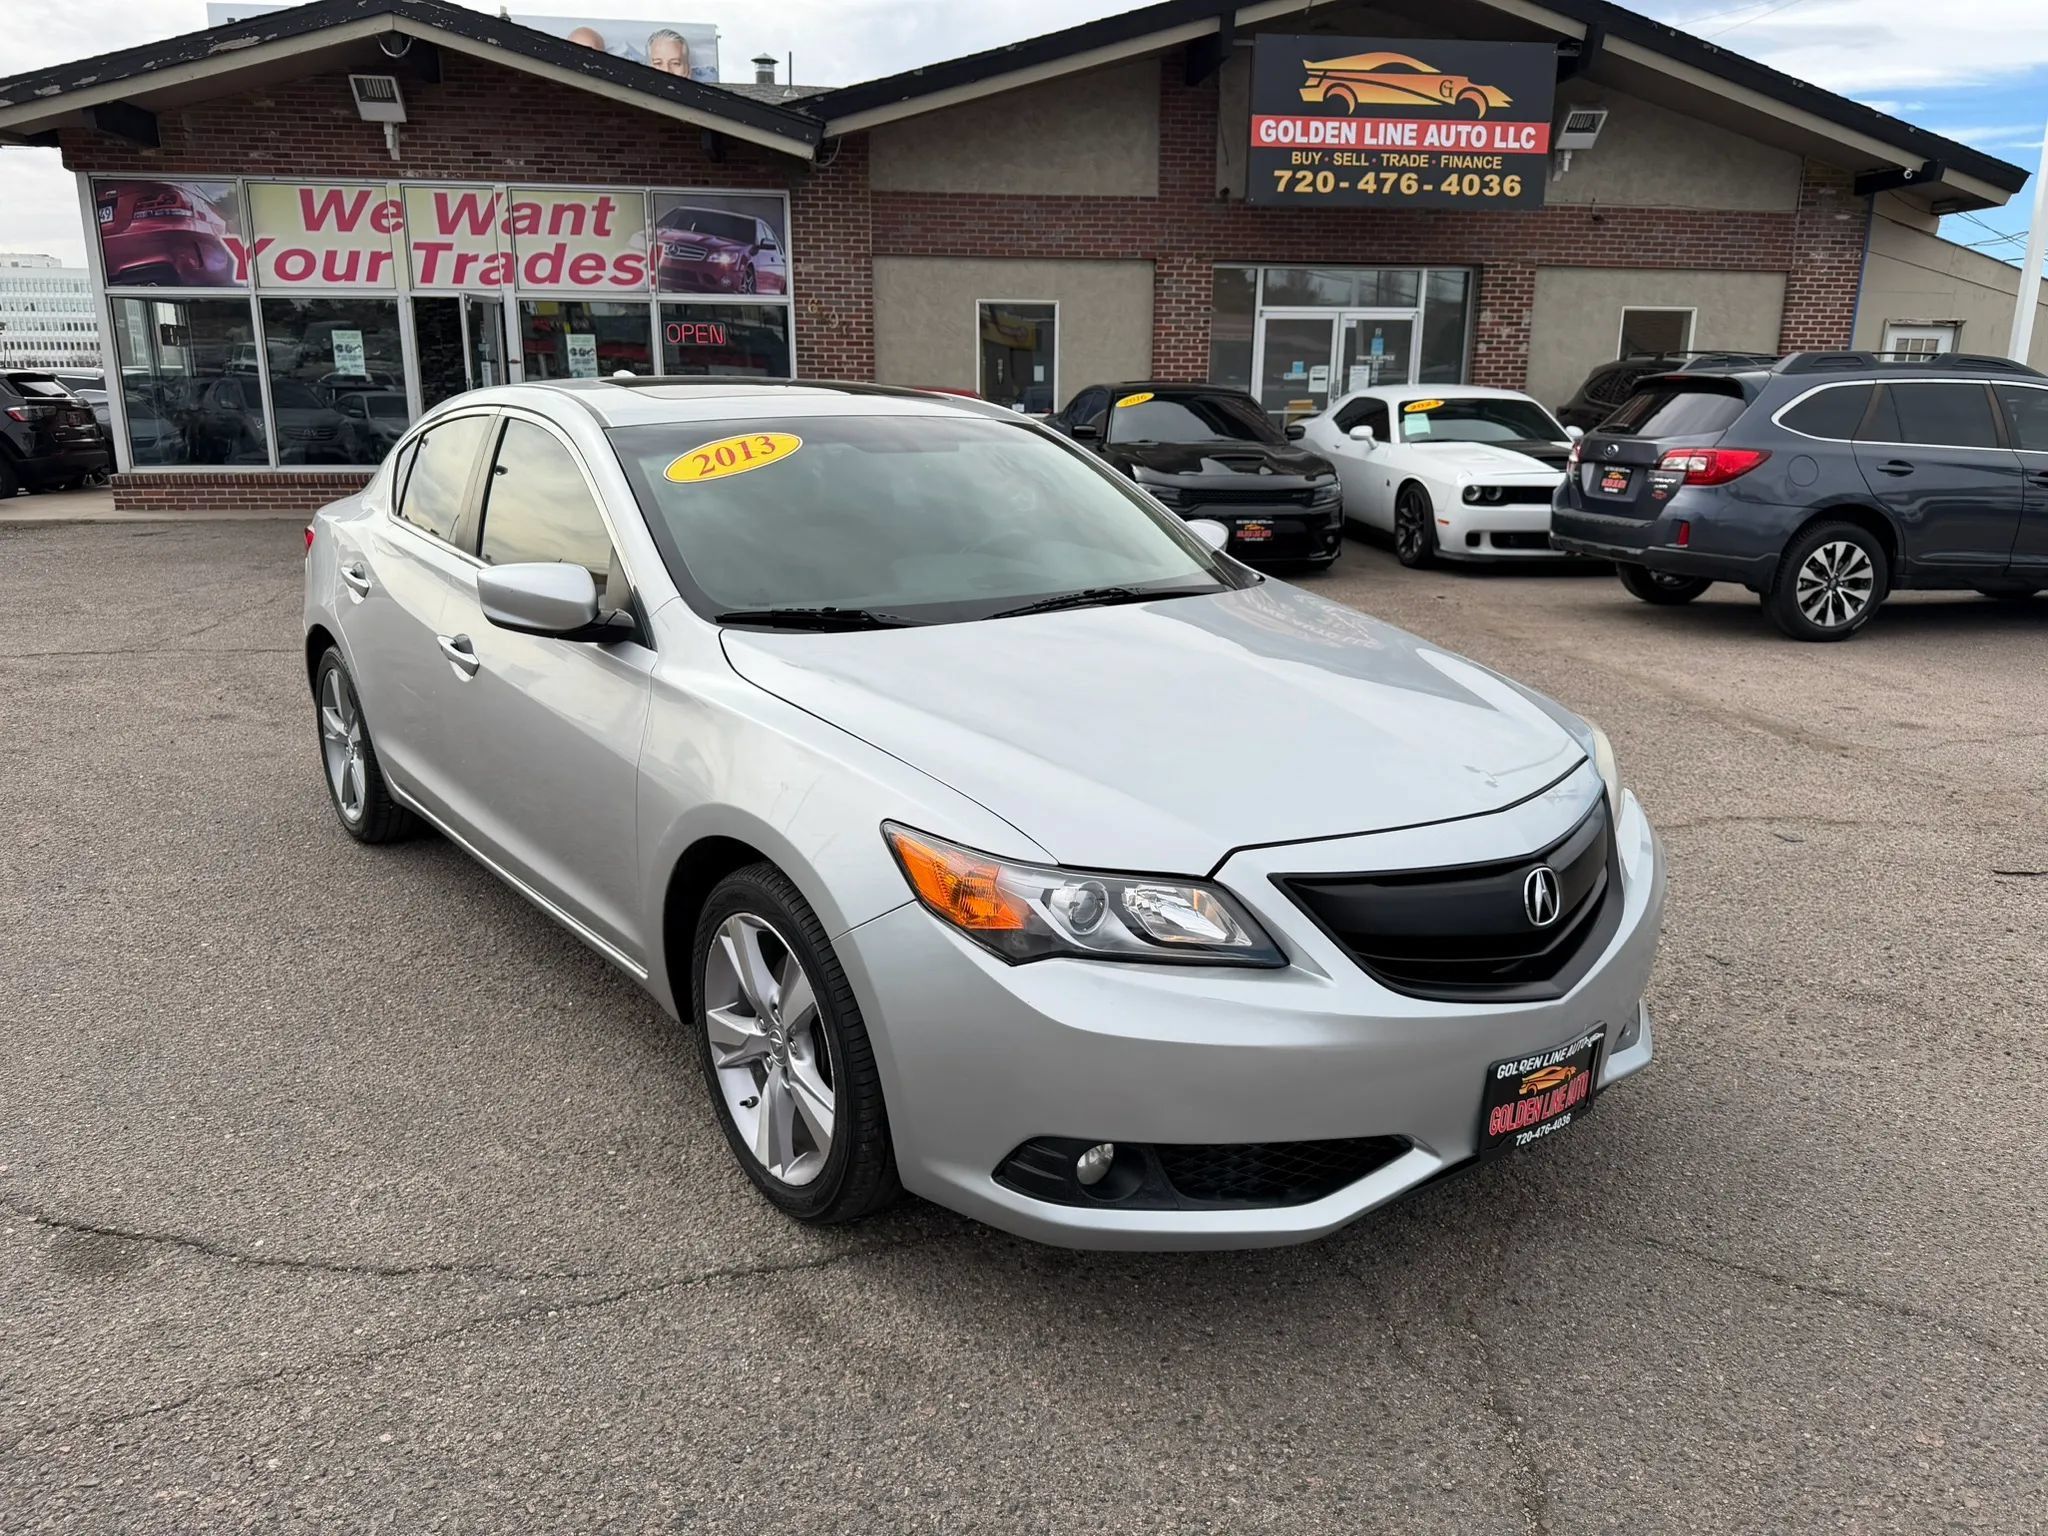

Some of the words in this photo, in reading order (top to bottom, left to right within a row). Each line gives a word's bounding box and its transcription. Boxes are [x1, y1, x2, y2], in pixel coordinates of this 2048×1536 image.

[1259, 119, 1356, 145] GOLDEN
[1363, 122, 1417, 146] LINE
[1423, 124, 1487, 148] AUTO
[1494, 126, 1536, 149] LLC
[1291, 152, 1322, 165] BUY
[1333, 153, 1369, 166] SELL
[1381, 154, 1429, 168] TRADE
[1440, 155, 1502, 169] FINANCE
[299, 188, 404, 233] We
[433, 192, 616, 237] Want
[223, 238, 393, 283] Your
[665, 323, 724, 344] OPEN
[693, 436, 775, 476] 2013
[1498, 1056, 1542, 1079] GOLDEN
[1543, 1048, 1567, 1067] LINE
[1489, 1095, 1543, 1136] GOLDEN
[1541, 1084, 1568, 1120] LINE
[1565, 1069, 1590, 1109] AUTO
[1516, 1113, 1571, 1146] 720-476-4036
